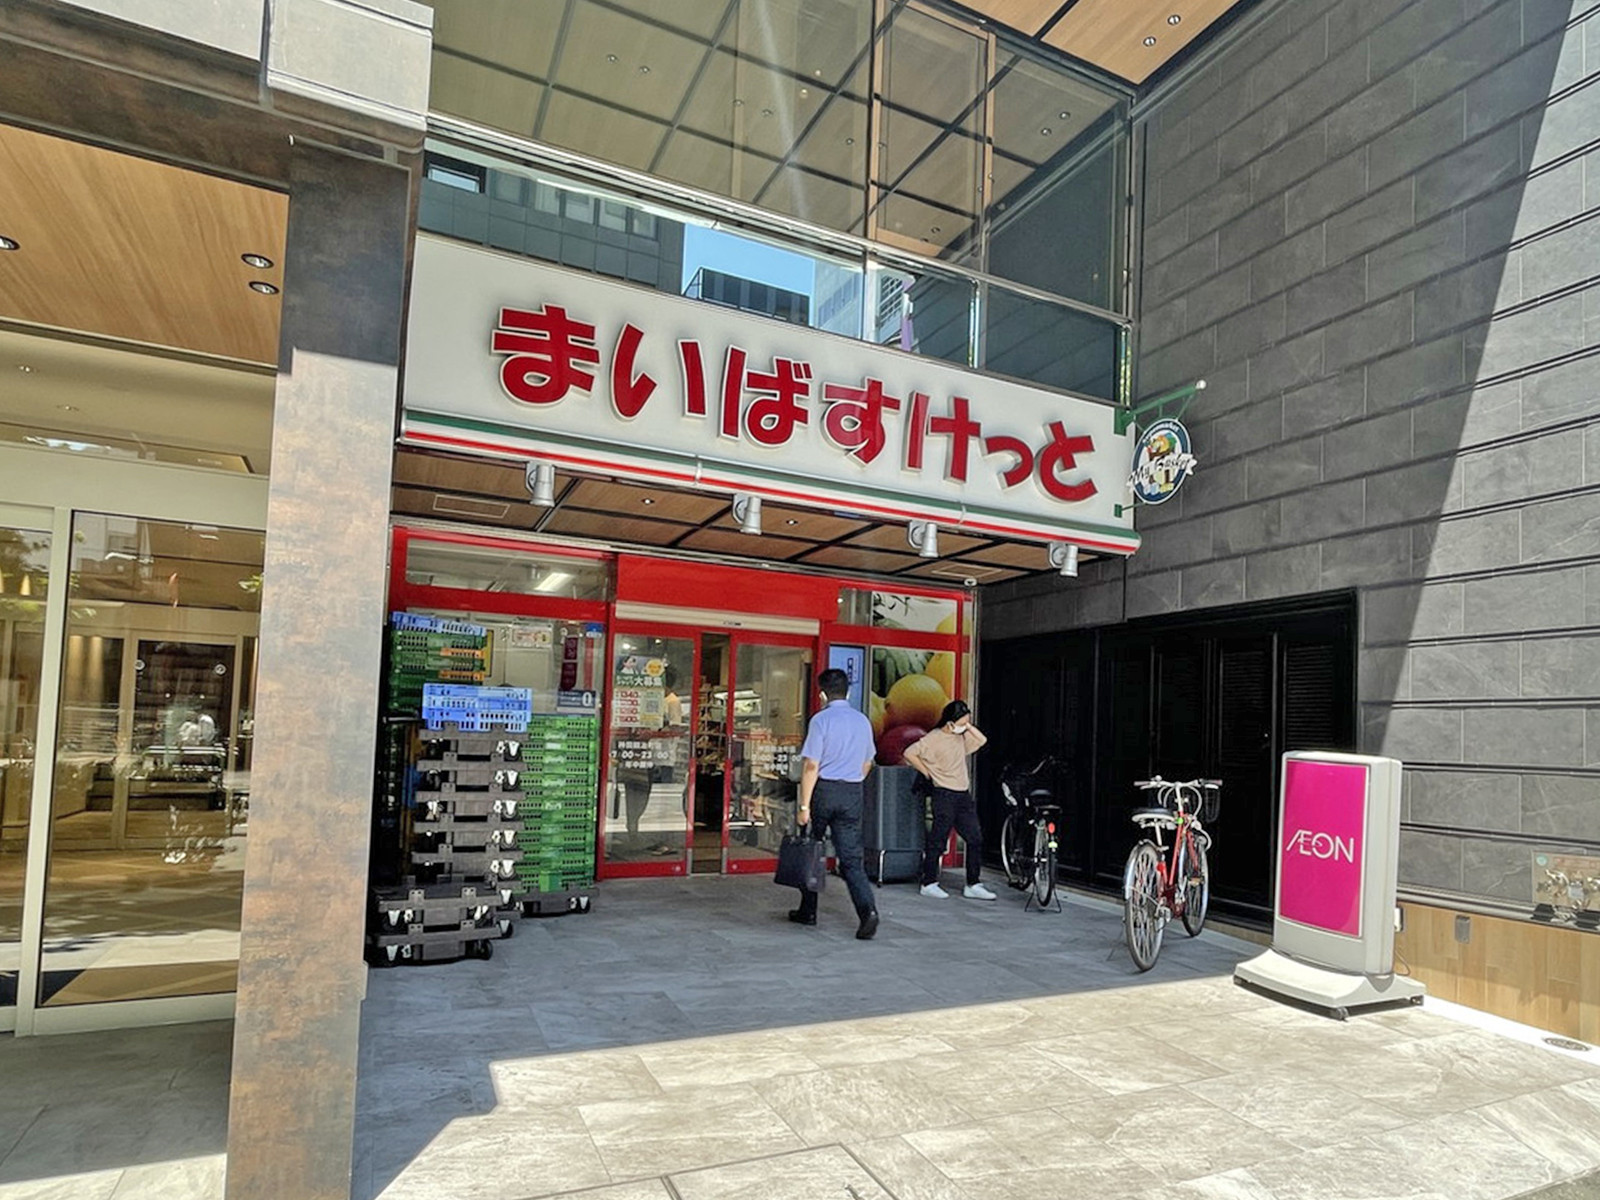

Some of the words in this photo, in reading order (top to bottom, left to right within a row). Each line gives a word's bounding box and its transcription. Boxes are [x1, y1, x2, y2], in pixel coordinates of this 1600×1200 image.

[491, 302, 1098, 504] まいばすけっと
